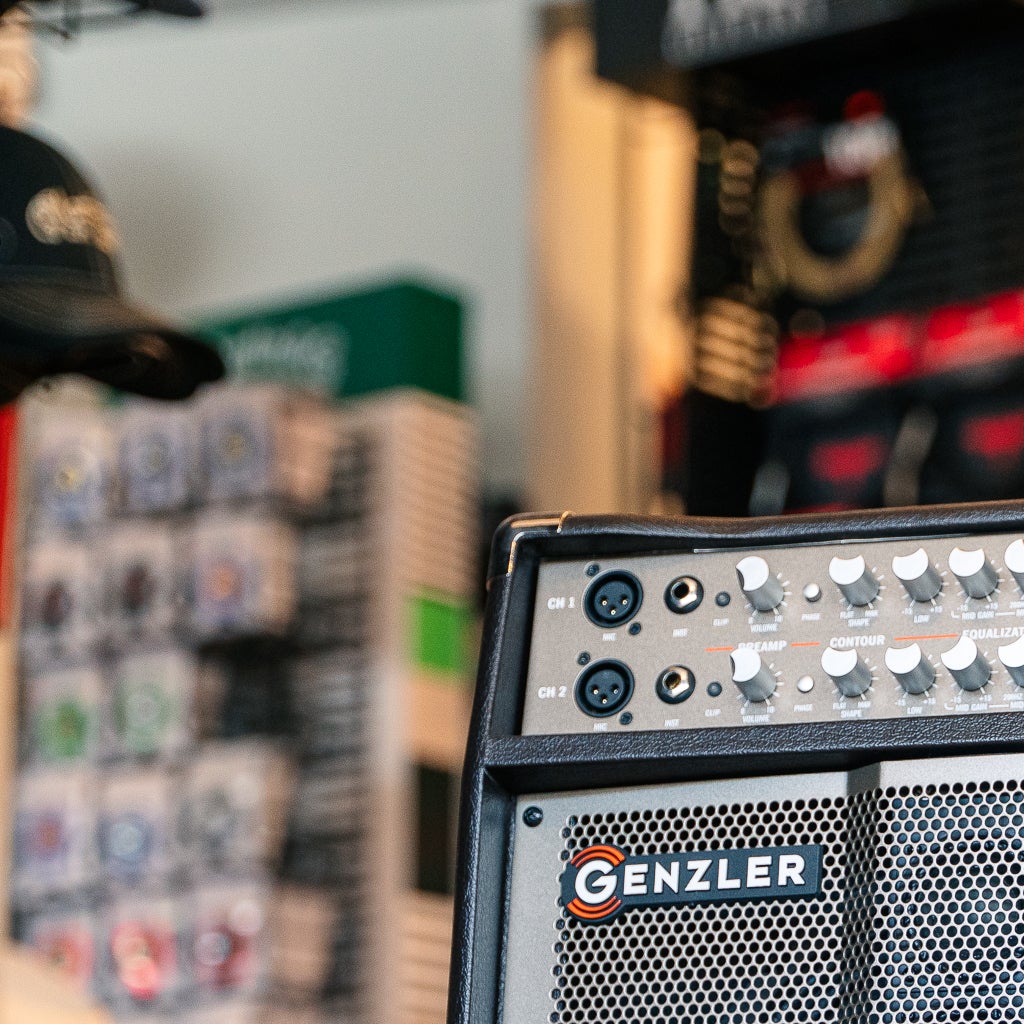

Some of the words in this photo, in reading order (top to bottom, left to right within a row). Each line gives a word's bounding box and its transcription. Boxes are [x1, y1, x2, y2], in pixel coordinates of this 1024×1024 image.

[547, 597, 565, 609] CH
[568, 597, 576, 608] 1
[914, 615, 930, 623] LOW
[830, 635, 886, 648] CONTOUR
[537, 686, 556, 699] CH
[558, 686, 567, 698] 2
[907, 706, 922, 714] LOW
[574, 854, 806, 904] GENZLER
